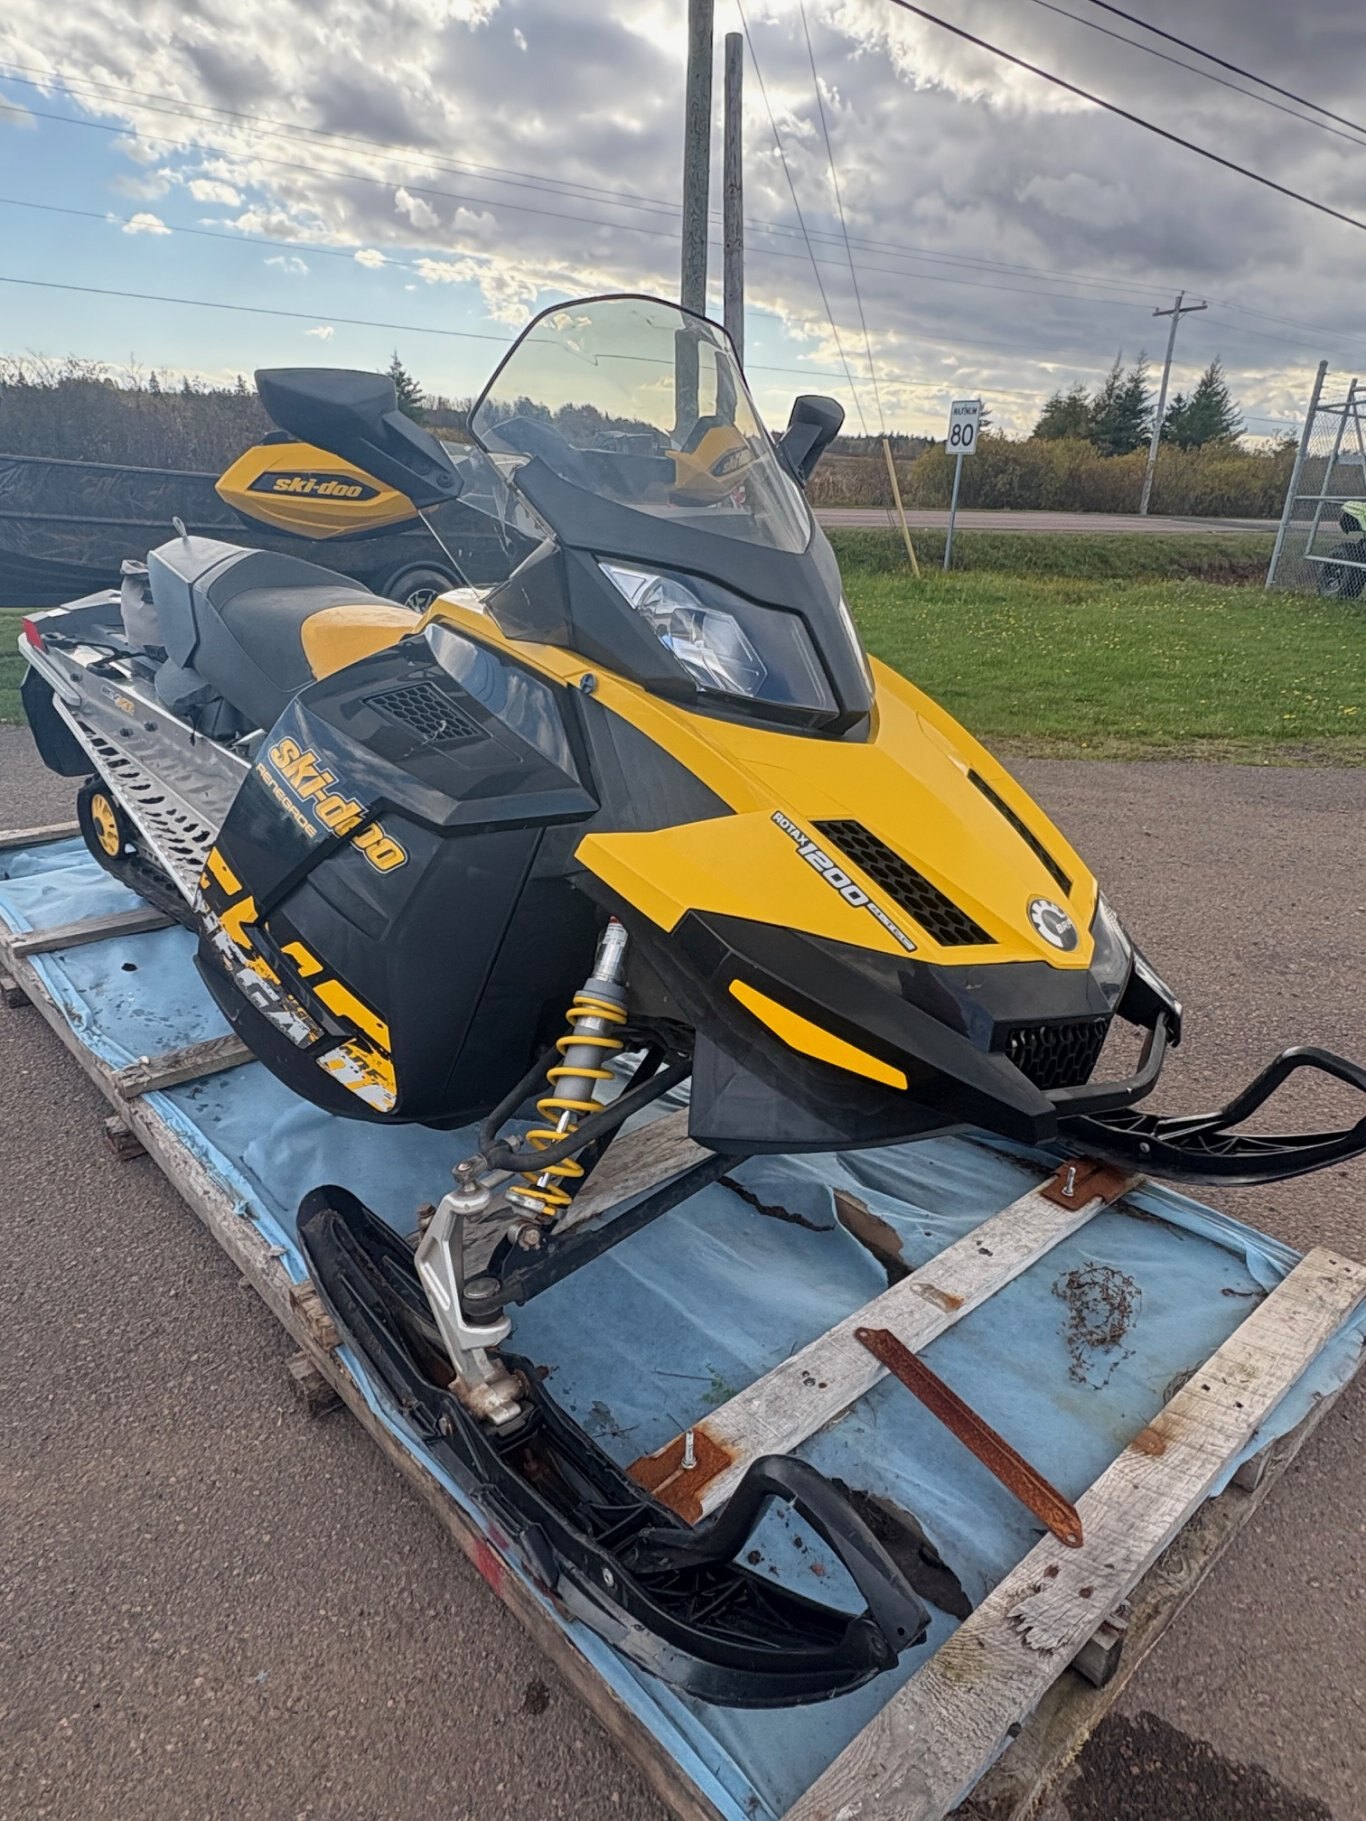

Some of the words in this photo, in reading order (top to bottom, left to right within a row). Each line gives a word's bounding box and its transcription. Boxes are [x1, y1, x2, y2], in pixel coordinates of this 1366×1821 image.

[951, 424, 973, 446] 80
[273, 477, 362, 497] ski-doo
[772, 811, 809, 846] ROTAX
[797, 842, 870, 907] 1200
